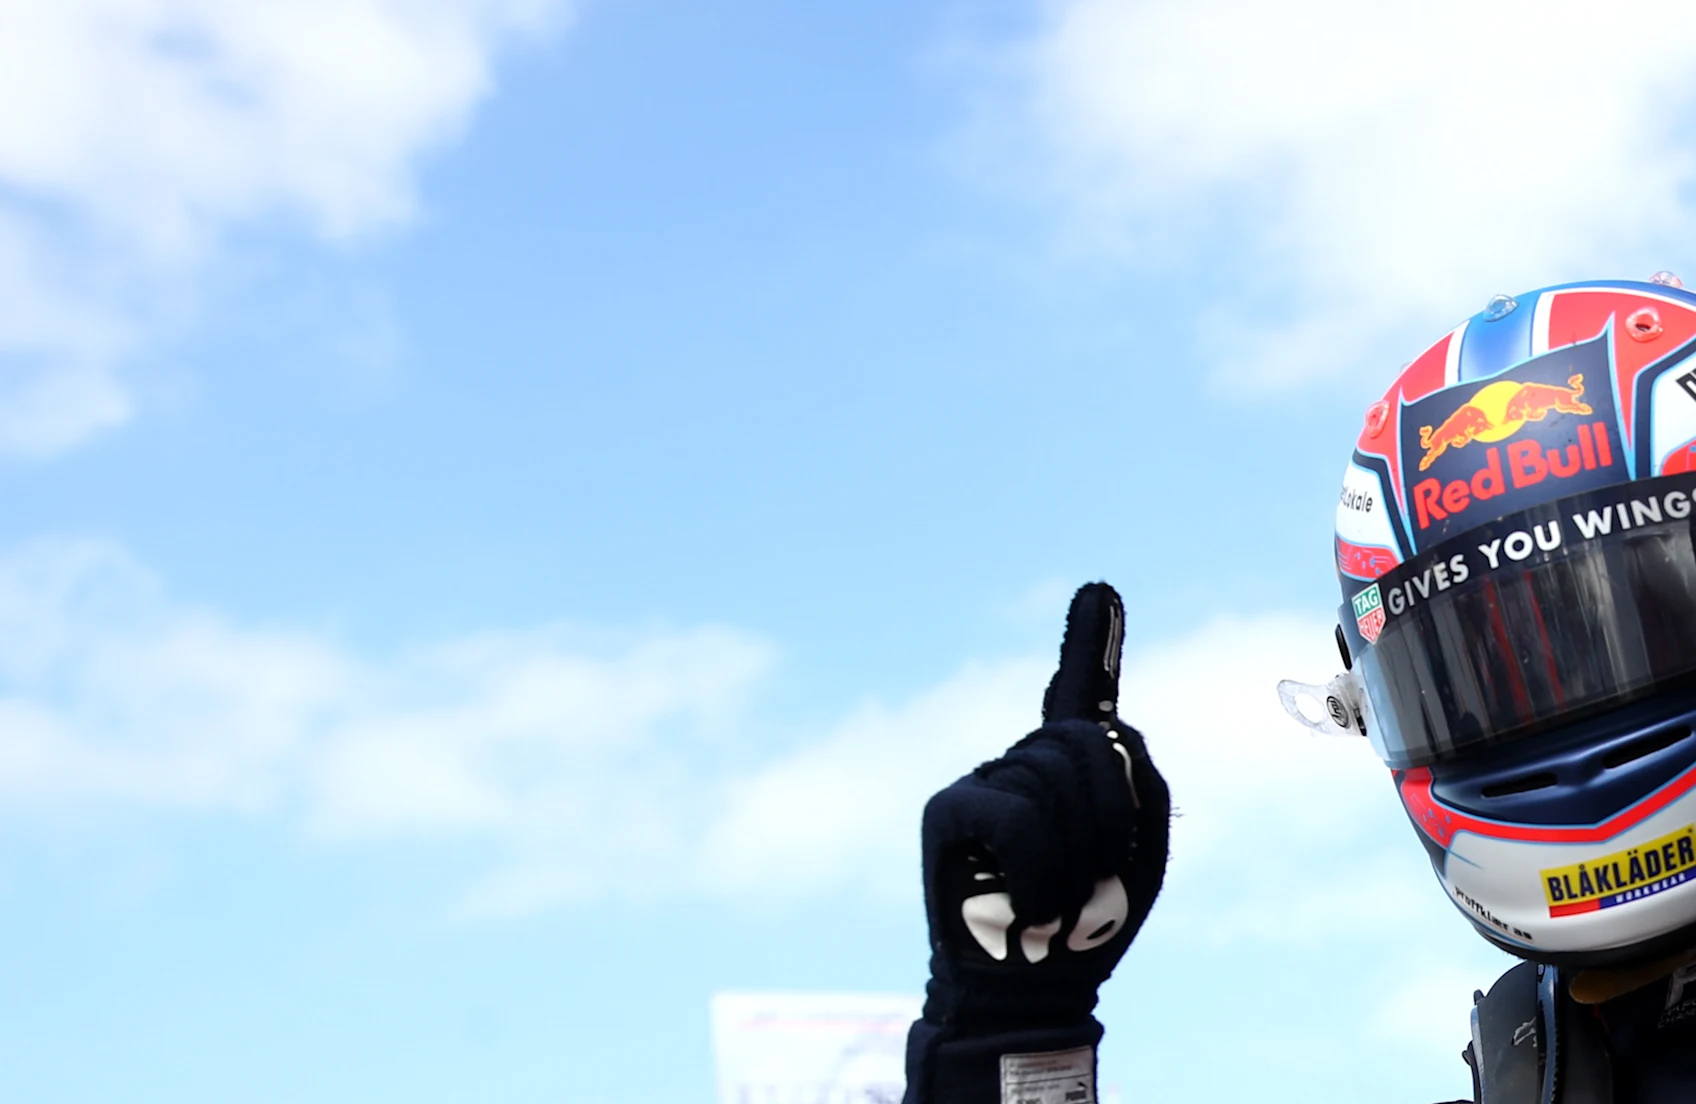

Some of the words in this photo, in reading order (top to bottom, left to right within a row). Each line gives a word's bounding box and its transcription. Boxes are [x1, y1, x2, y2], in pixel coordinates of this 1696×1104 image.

[1412, 447, 1505, 530] Red
[1507, 421, 1613, 489] Bull
[1353, 587, 1379, 616] TAG
[1388, 554, 1470, 617] GIVES
[1478, 520, 1562, 571] YOU
[1547, 835, 1696, 902] BLÅKLÄDER
